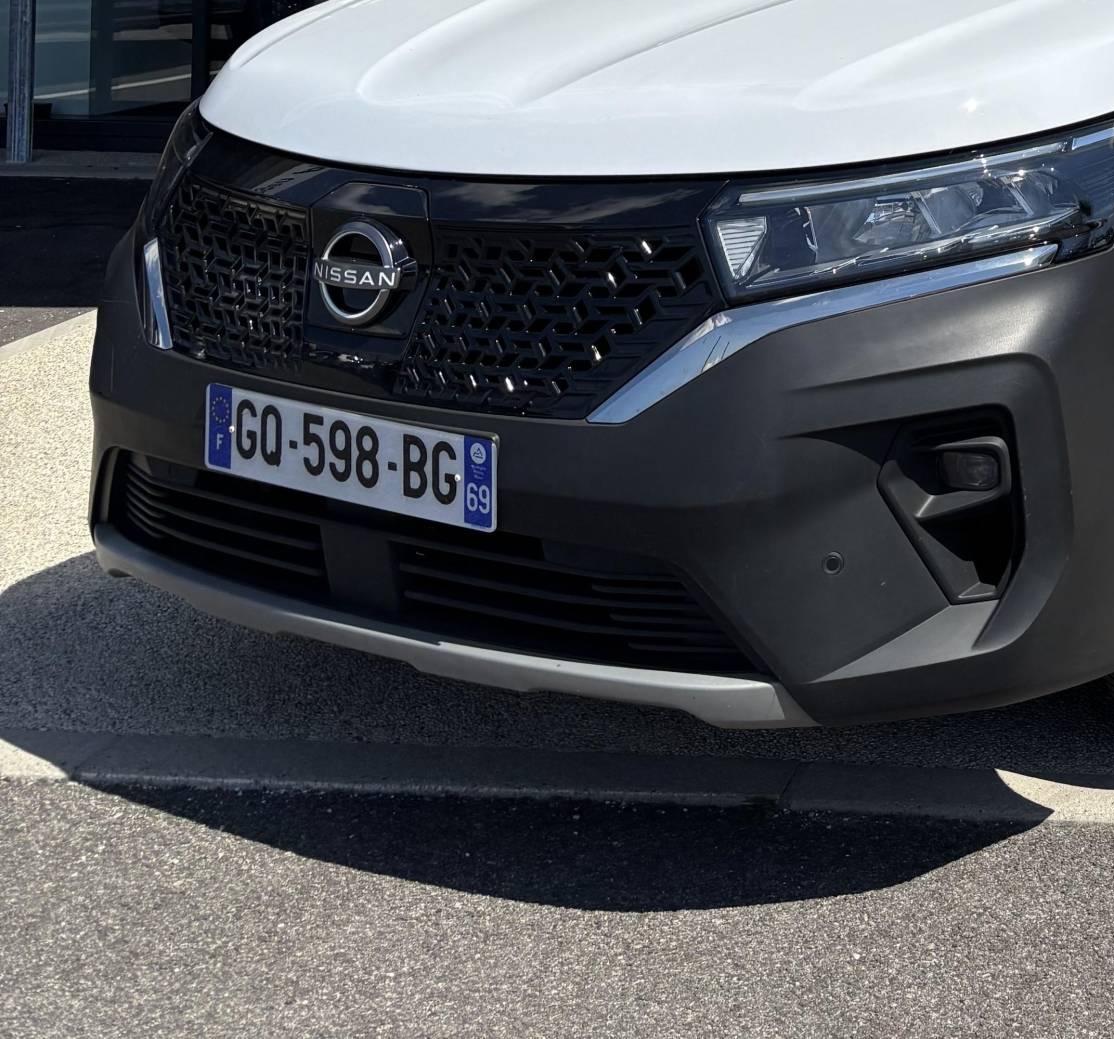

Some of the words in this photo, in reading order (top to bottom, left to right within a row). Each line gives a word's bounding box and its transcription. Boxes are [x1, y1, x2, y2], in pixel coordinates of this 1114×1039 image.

[313, 261, 396, 286] NISSAN
[216, 433, 225, 450] F
[236, 399, 457, 505] GQ-598-BG
[466, 481, 491, 515] 69
